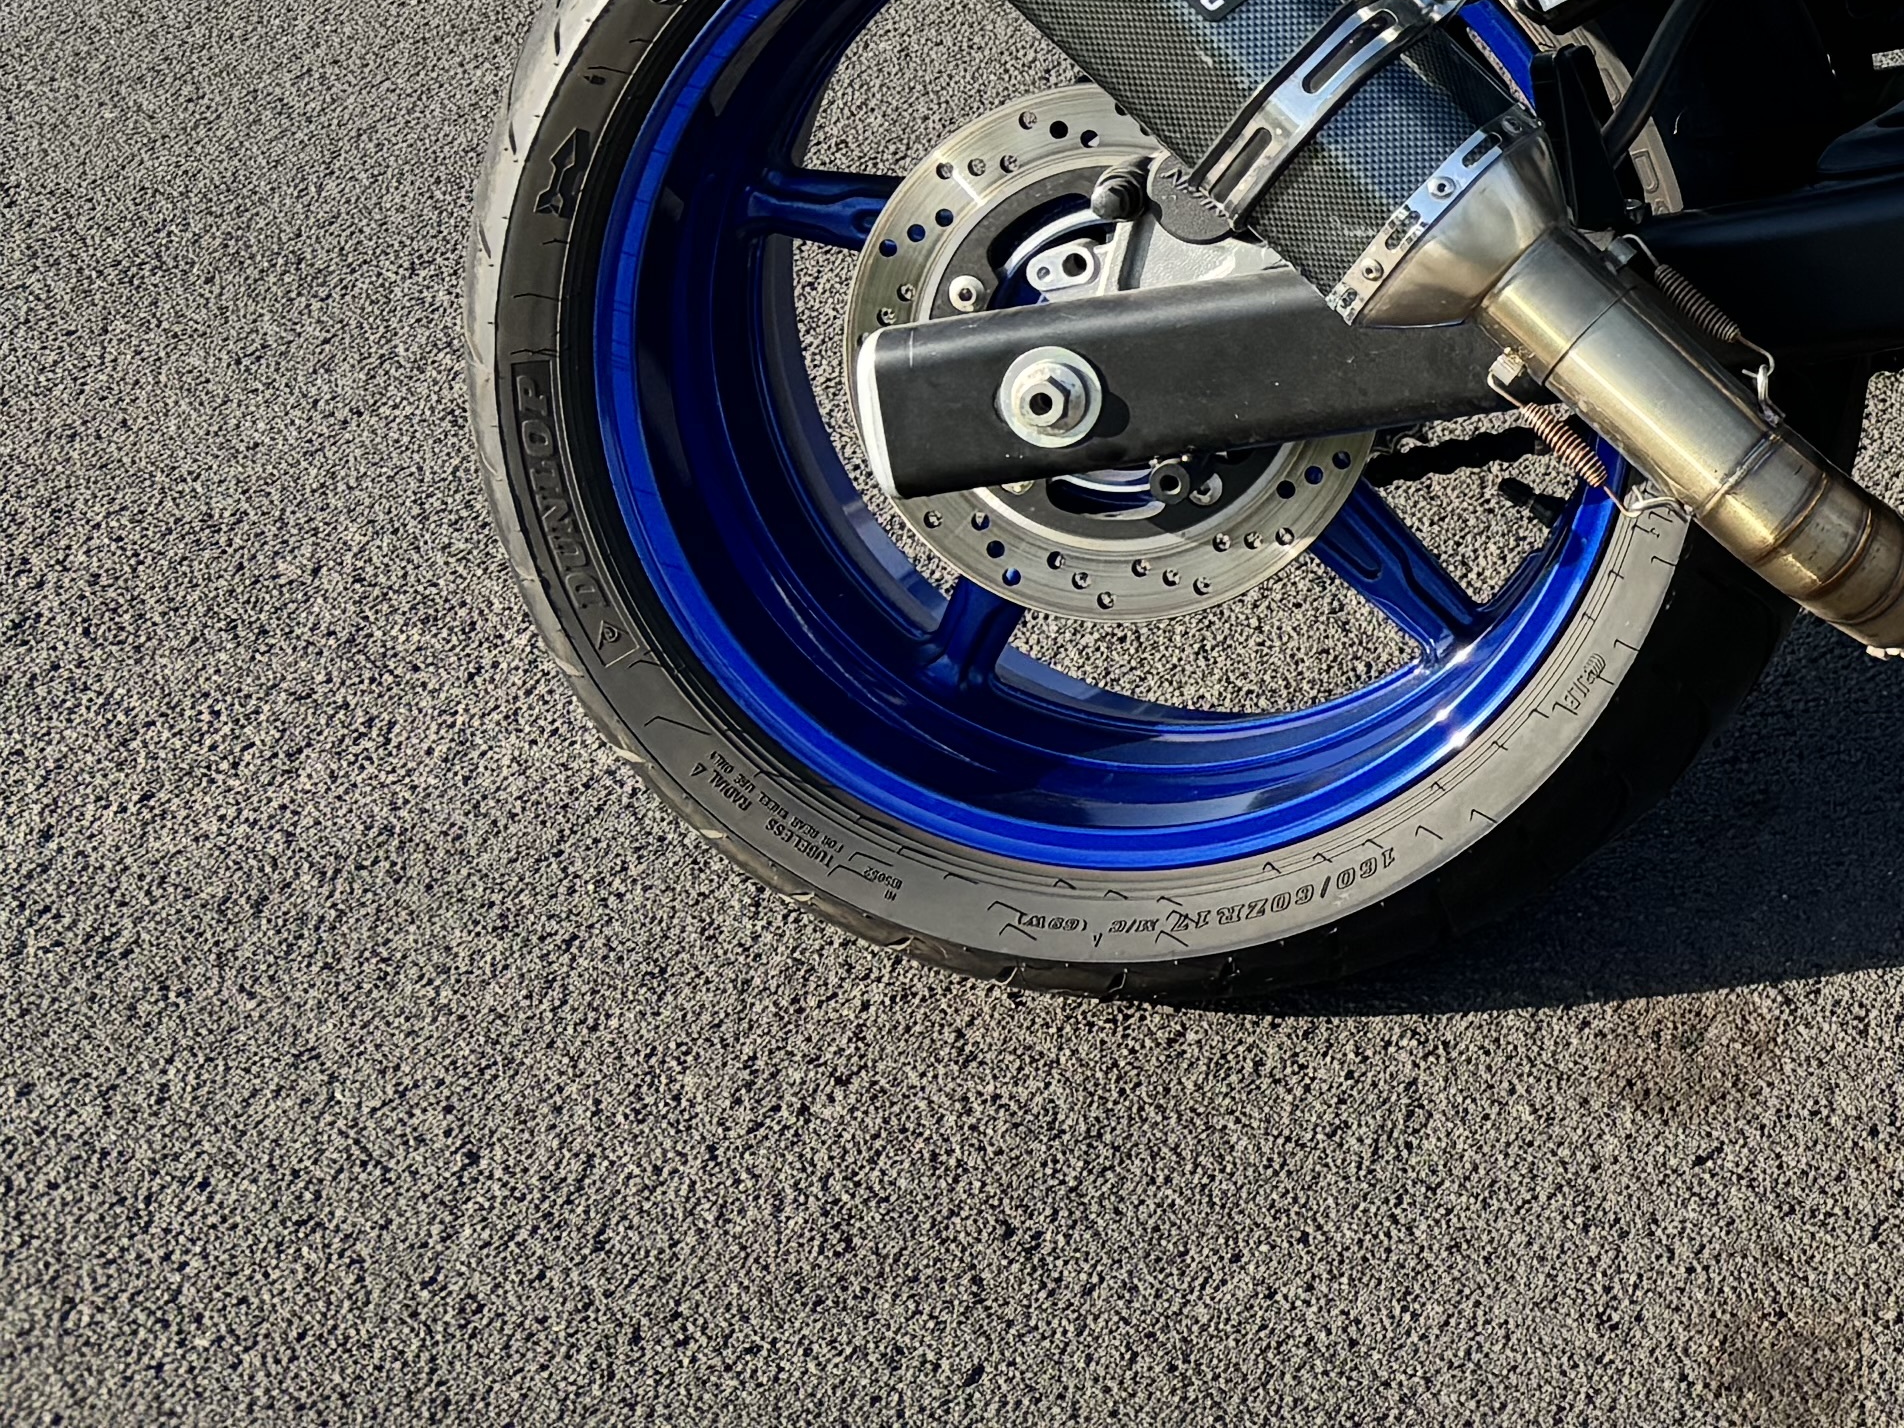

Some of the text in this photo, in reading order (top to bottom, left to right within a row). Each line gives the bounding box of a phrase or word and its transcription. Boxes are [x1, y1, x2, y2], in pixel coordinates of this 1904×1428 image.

[516, 373, 608, 609] DUNLOP
[706, 772, 834, 869] TUBELESS RADIAL
